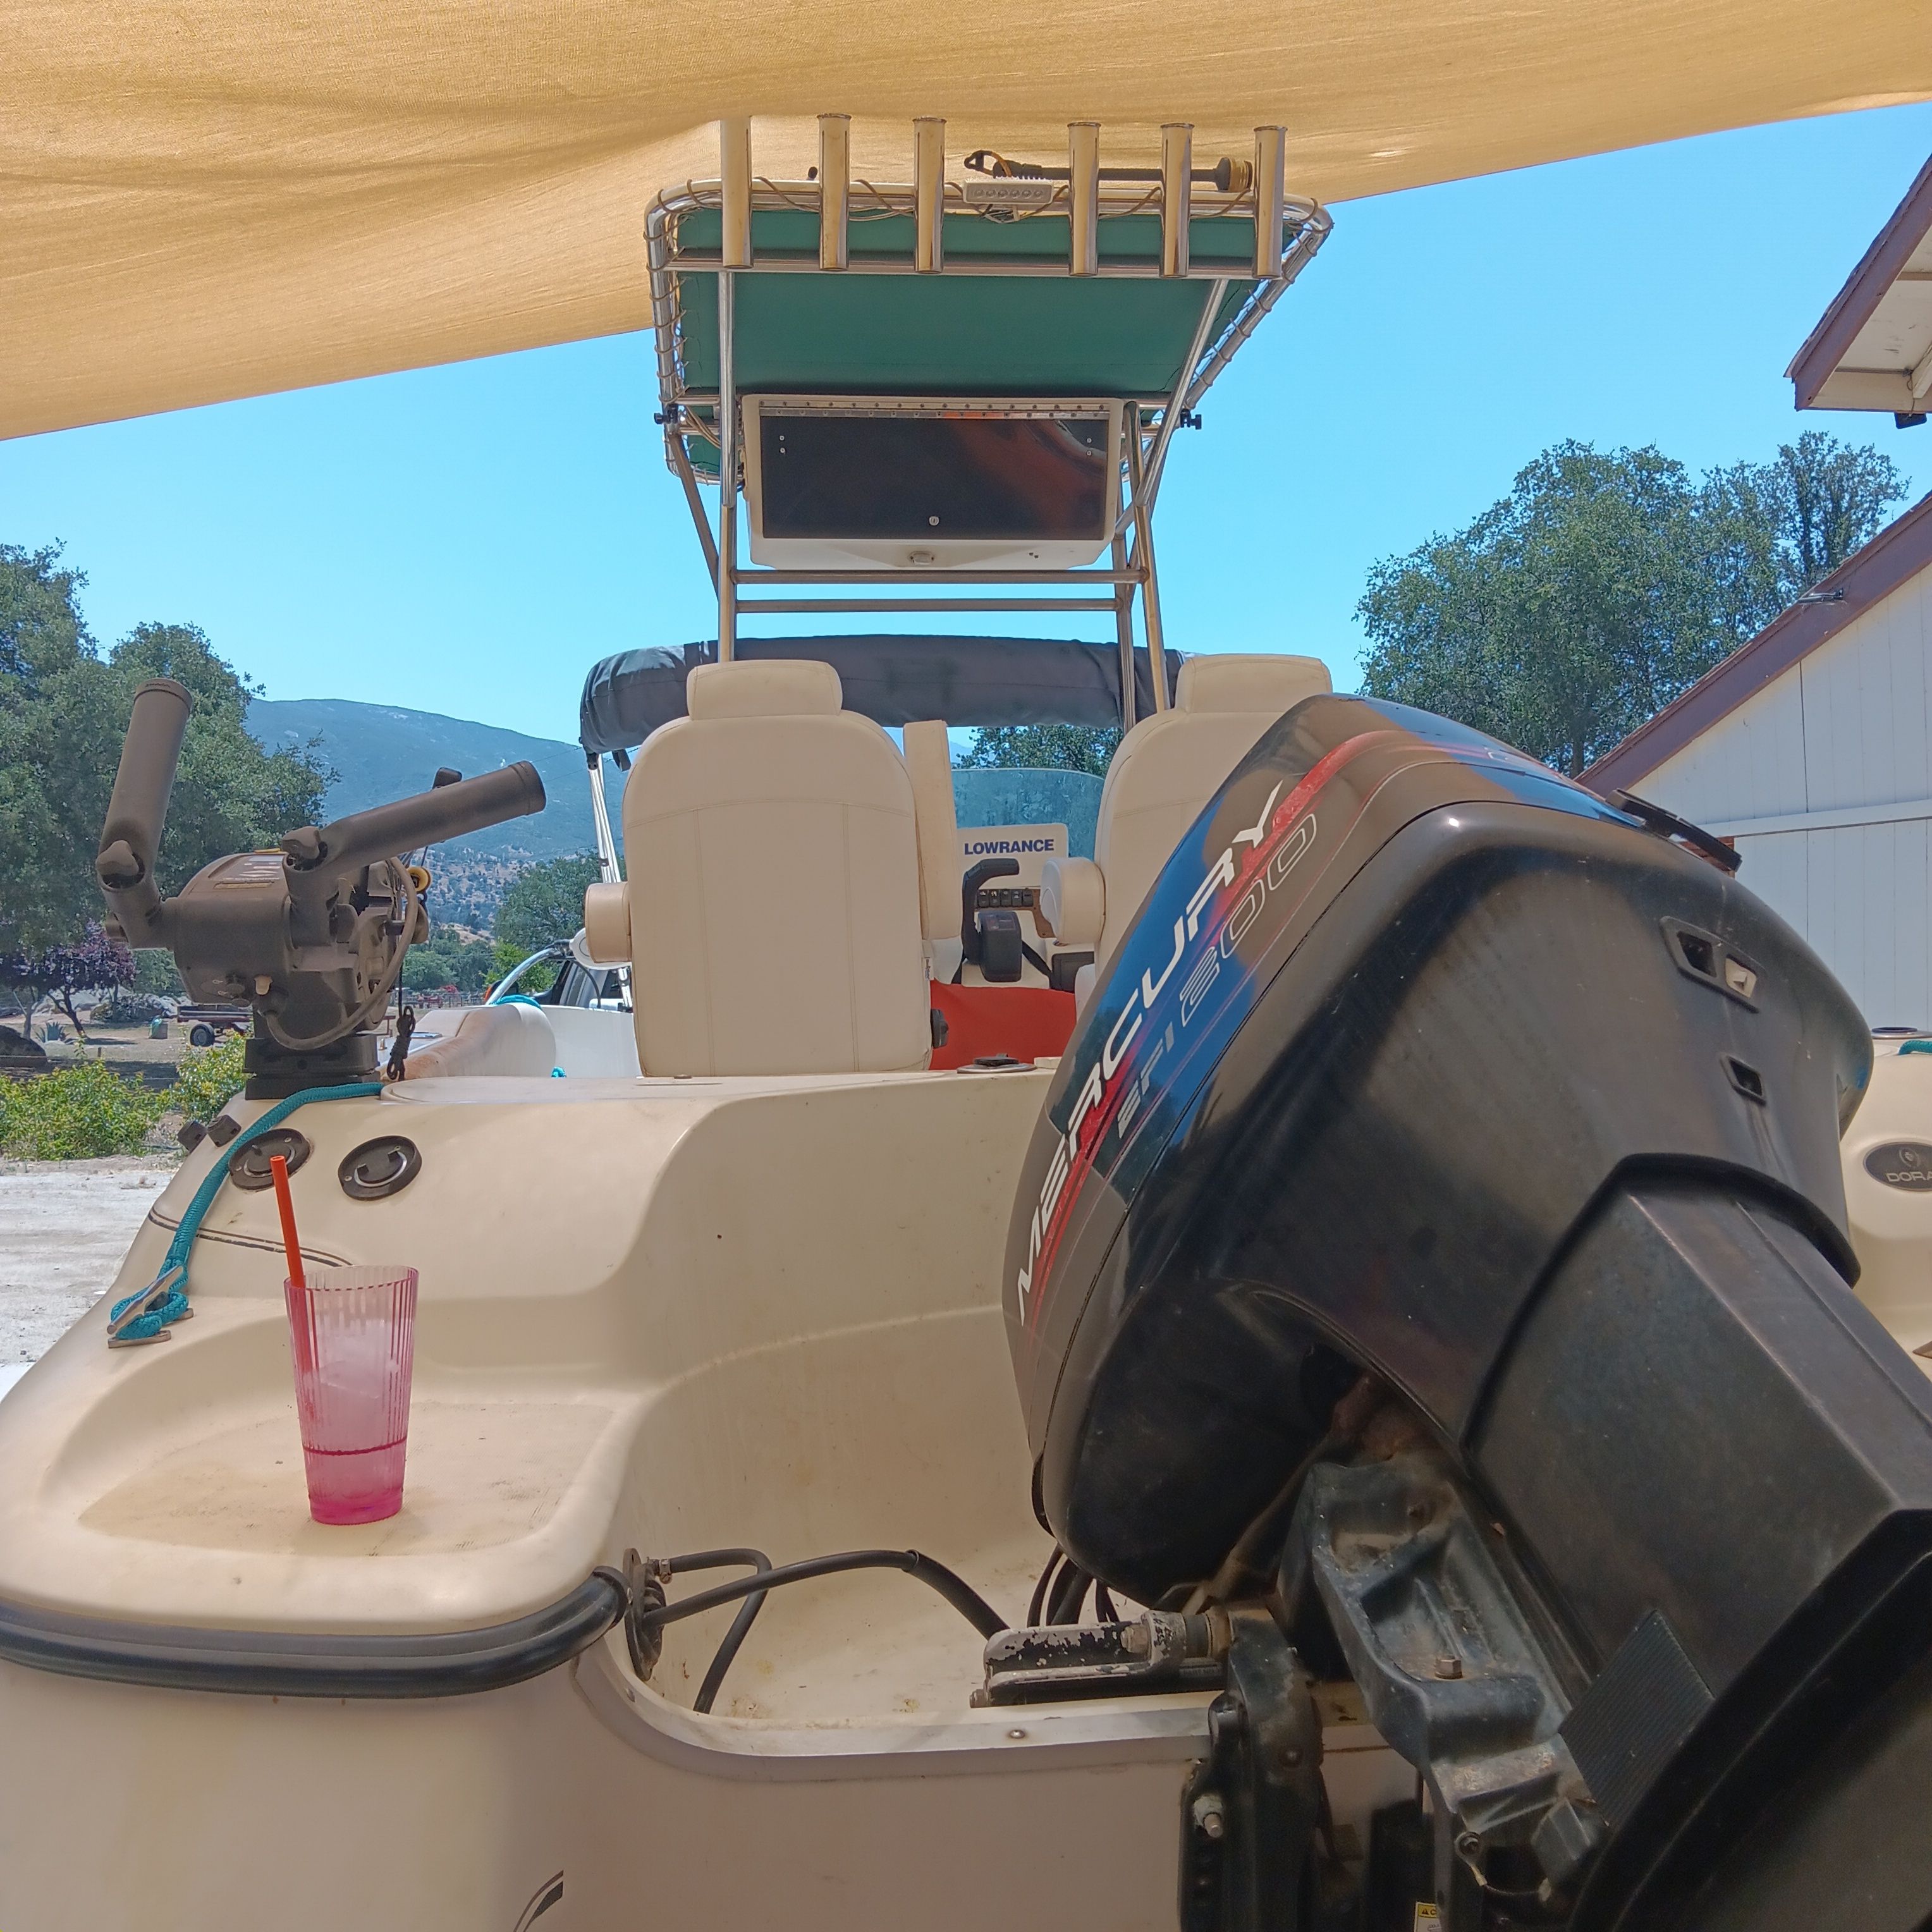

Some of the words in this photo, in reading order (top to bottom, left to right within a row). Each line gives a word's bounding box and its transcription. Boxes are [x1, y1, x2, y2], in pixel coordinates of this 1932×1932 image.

[964, 839, 1055, 855] LOWRANCE
[1116, 1021, 1174, 1139] EFI
[1180, 813, 1317, 1027] 200
[1017, 780, 1283, 1326] MERCURY
